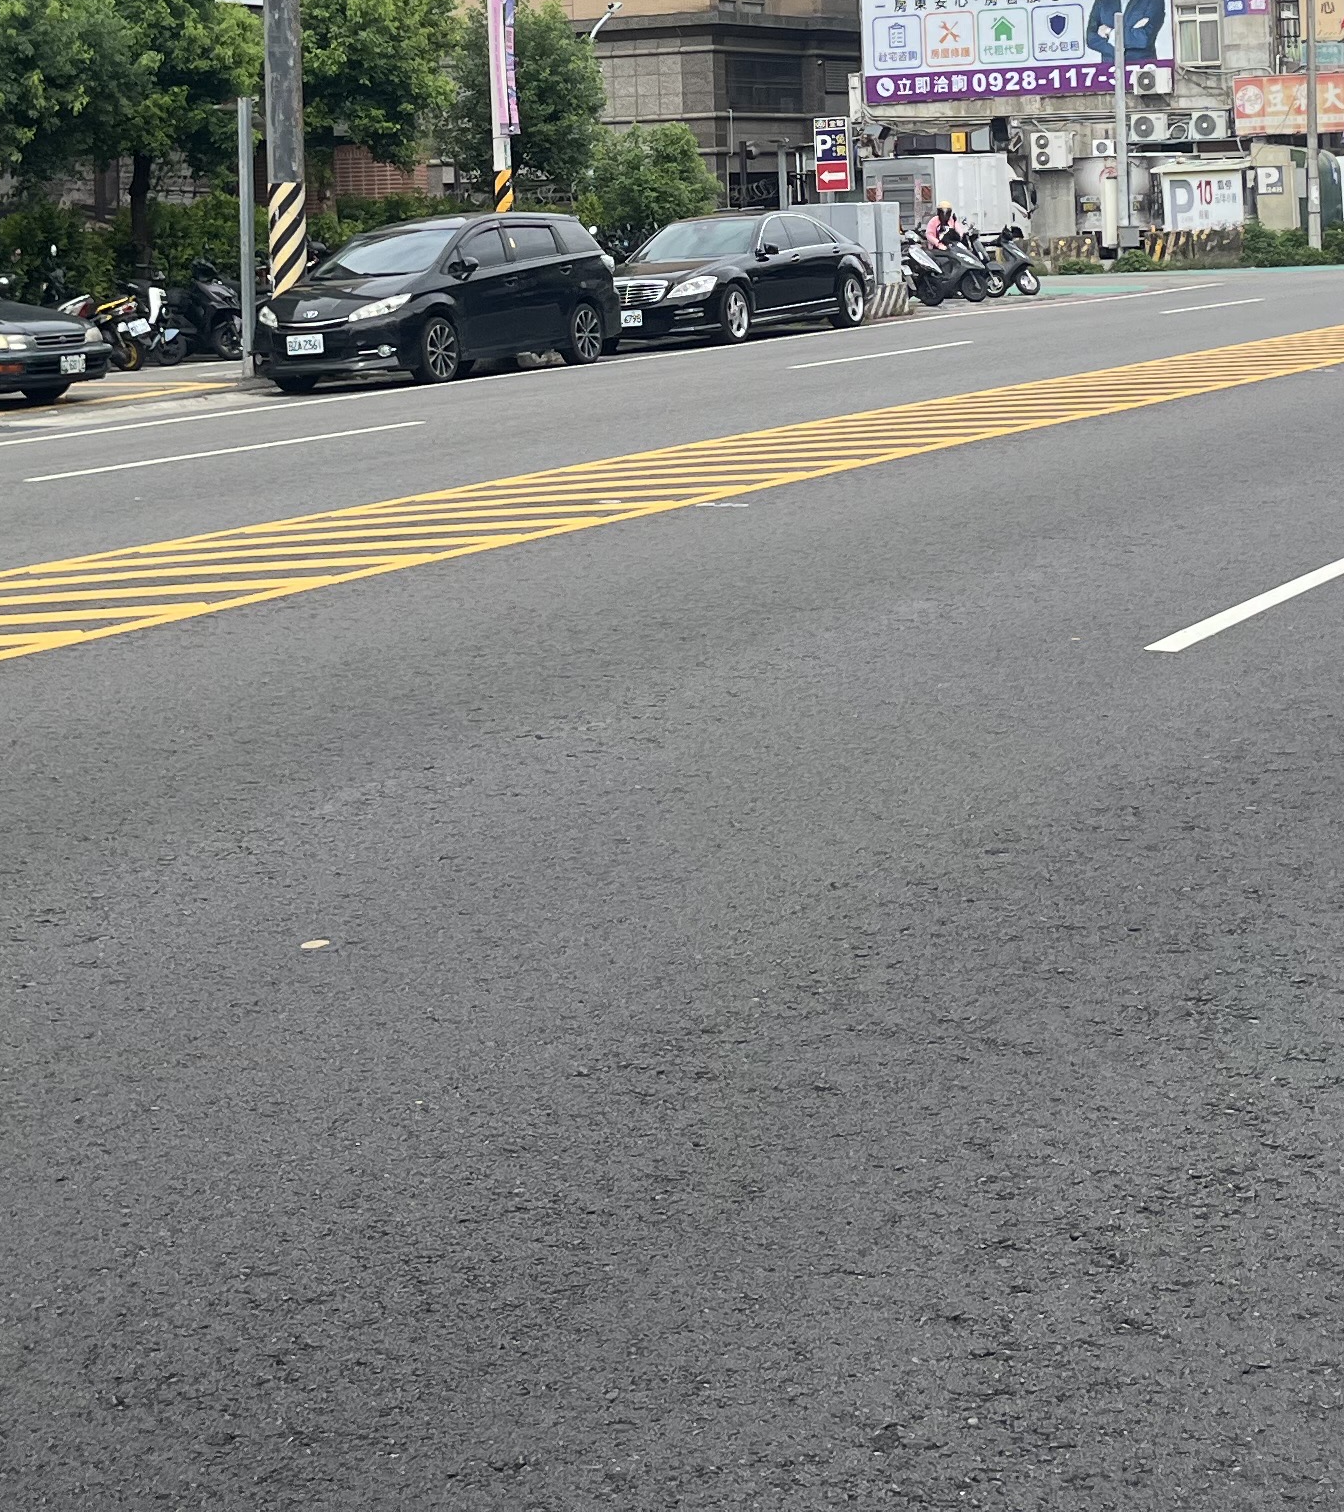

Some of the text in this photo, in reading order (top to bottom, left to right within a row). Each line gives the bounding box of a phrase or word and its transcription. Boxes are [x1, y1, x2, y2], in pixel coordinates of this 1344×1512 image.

[897, 73, 968, 94] 立即洽詢
[816, 135, 832, 157] P
[1197, 180, 1213, 205] 10
[1257, 167, 1280, 195] P
[1170, 179, 1194, 230] P
